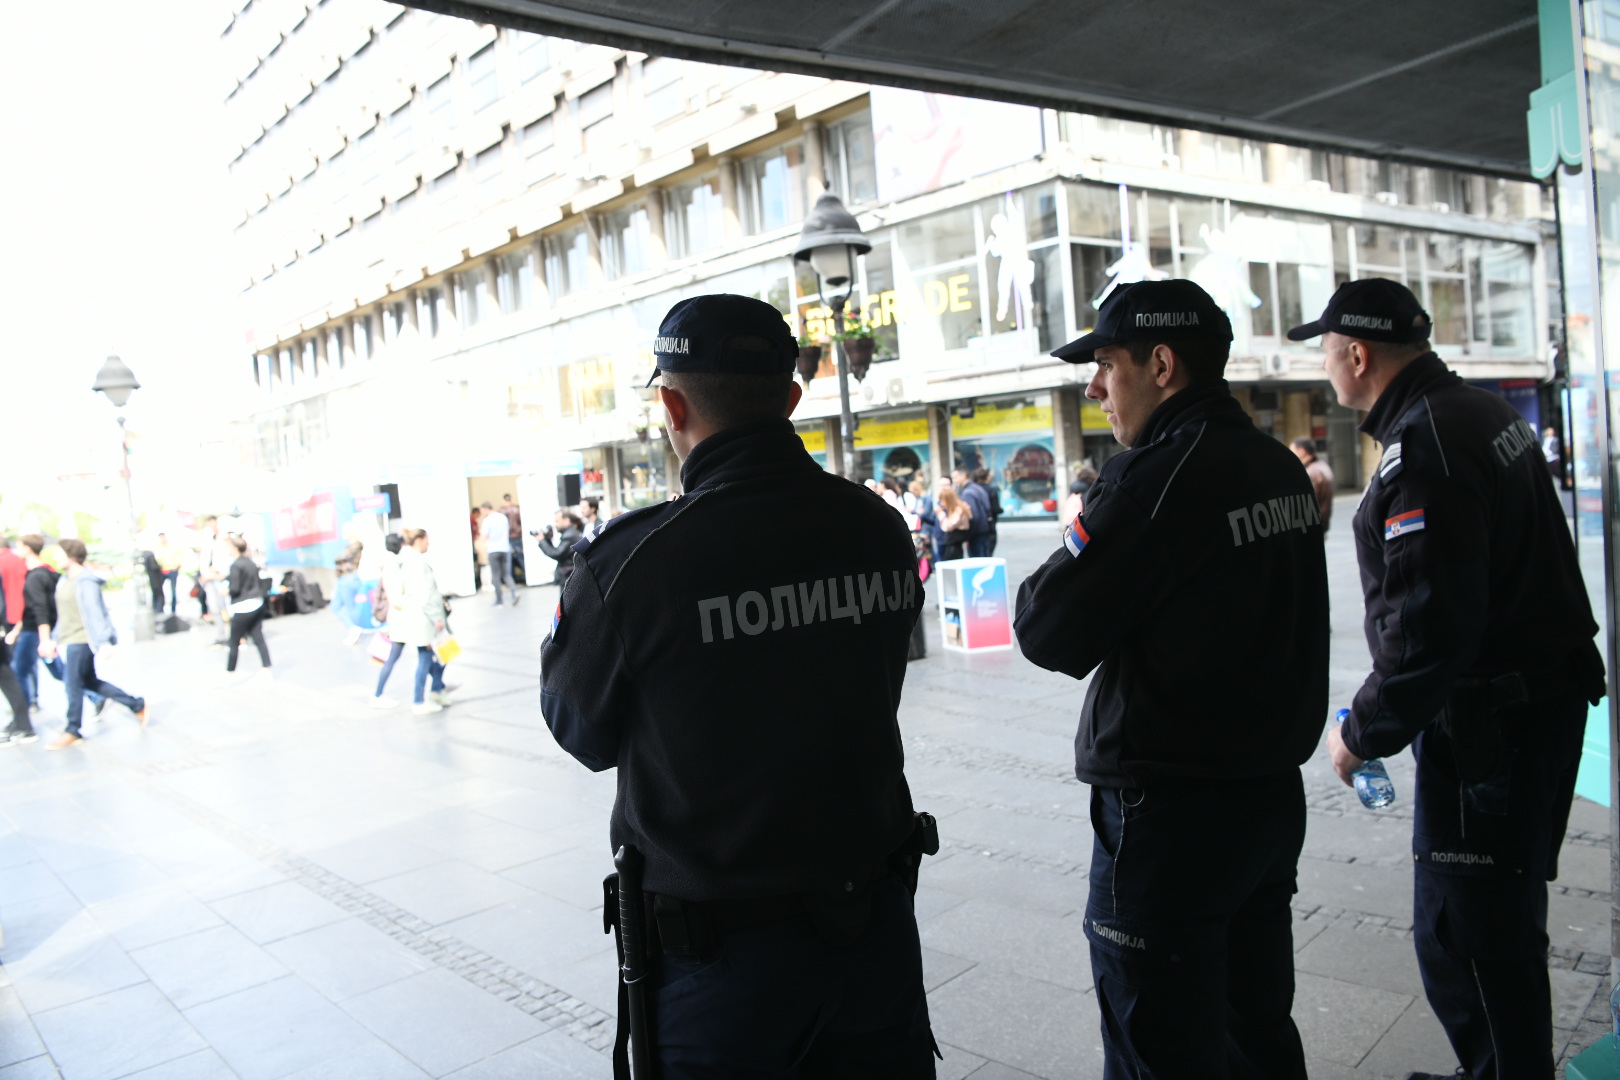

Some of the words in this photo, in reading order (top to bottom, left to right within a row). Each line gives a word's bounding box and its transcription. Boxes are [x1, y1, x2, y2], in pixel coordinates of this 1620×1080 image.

[805, 274, 972, 341] BEGRDE
[1135, 311, 1200, 328] ПОЛИЦИЈА
[1340, 313, 1393, 331] ПОЛИЦИЈА
[1226, 493, 1321, 547] ПОЛИЦИ
[697, 569, 916, 644] ПОЛИЦИЈА
[1431, 851, 1494, 865] ПОЛИЦИЈА
[1092, 920, 1146, 950] ПОЛИЦИЈА
